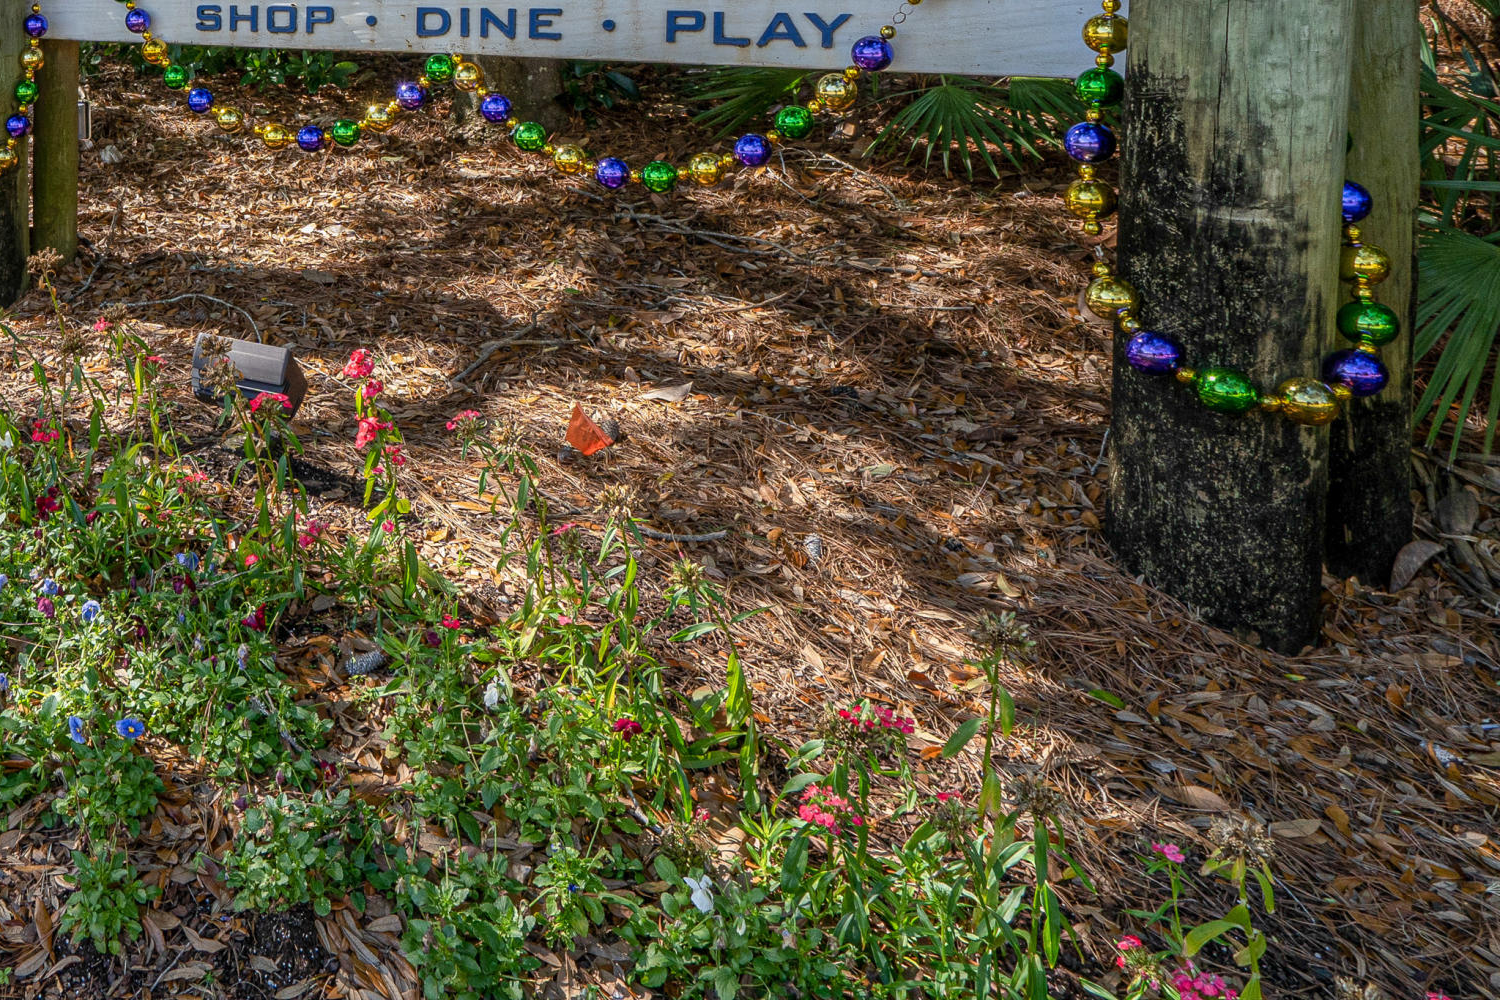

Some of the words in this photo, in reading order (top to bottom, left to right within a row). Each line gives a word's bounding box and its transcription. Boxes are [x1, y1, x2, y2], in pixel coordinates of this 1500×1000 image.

[195, 4, 335, 34] SHOP
[416, 6, 563, 41] DINE
[665, 9, 853, 49] PLAY
